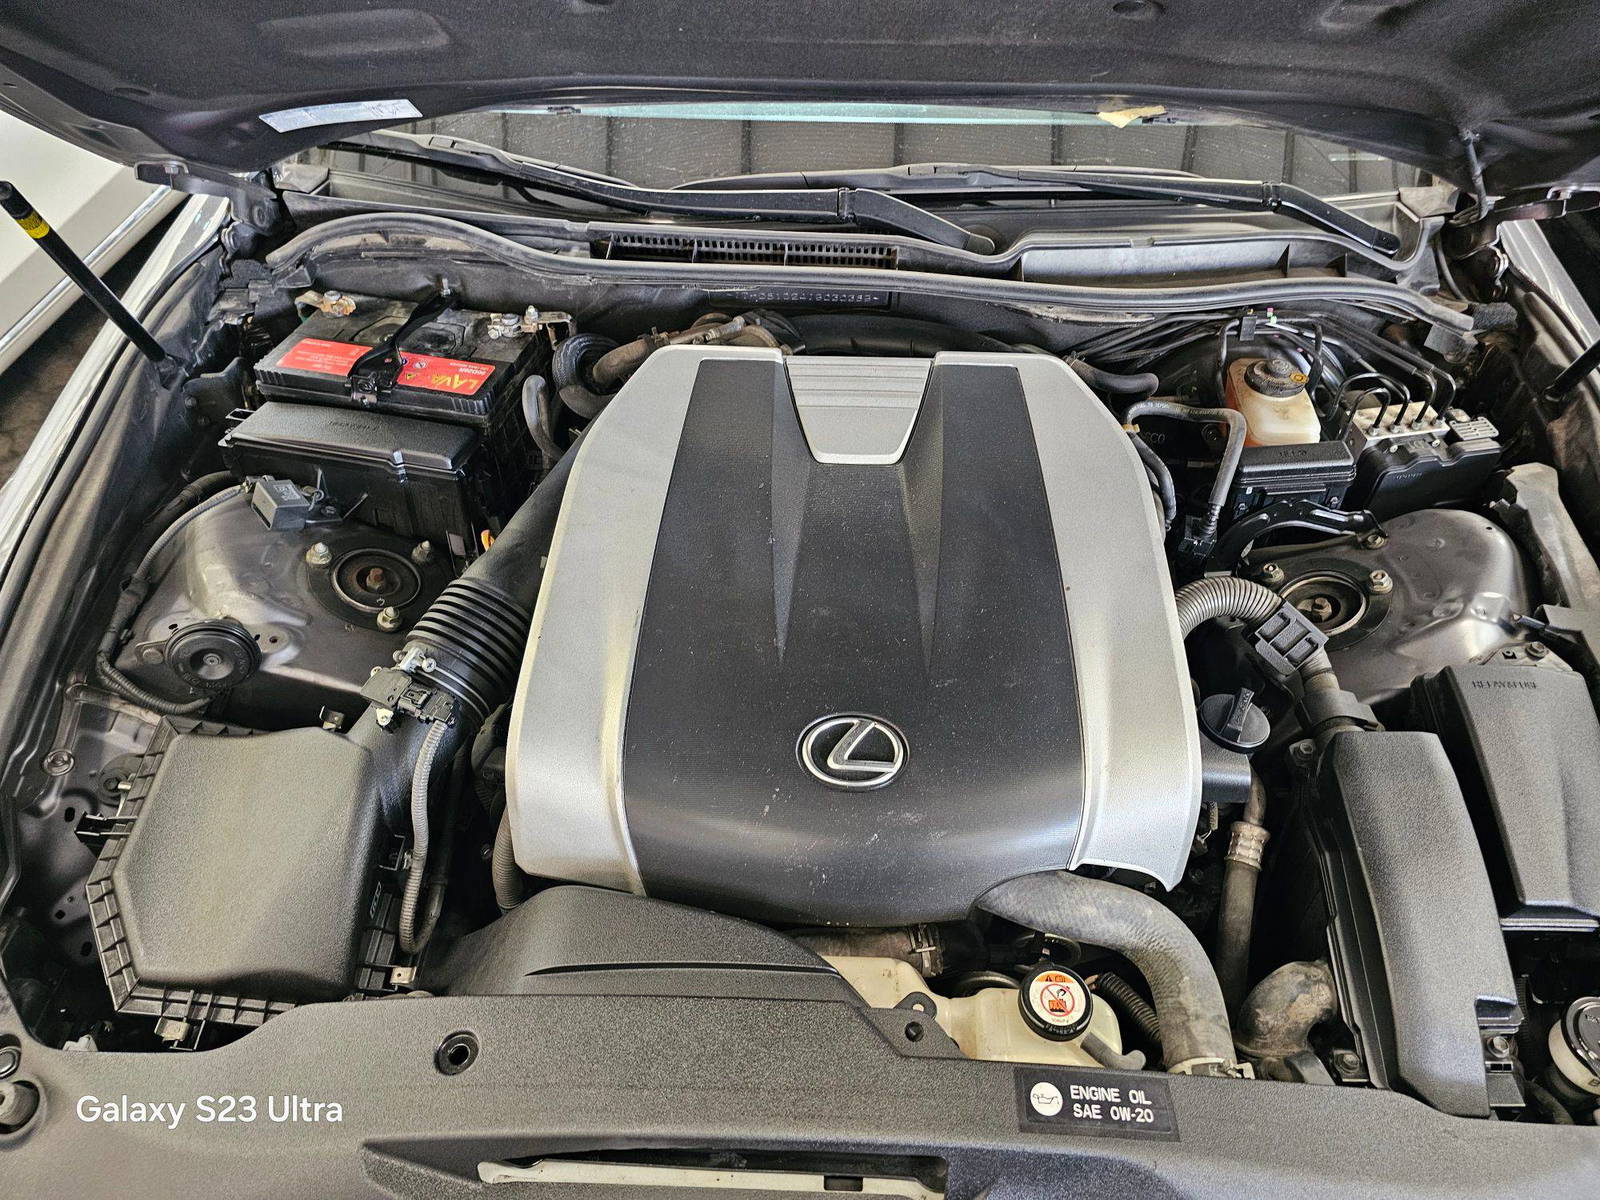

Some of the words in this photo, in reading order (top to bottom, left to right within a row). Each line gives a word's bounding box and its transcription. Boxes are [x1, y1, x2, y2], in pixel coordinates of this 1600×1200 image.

[1069, 1084, 1121, 1103] ENGINE
[1128, 1089, 1152, 1105] OIL
[1073, 1103, 1103, 1119] SAE
[1110, 1106, 1154, 1123] 0W-20
